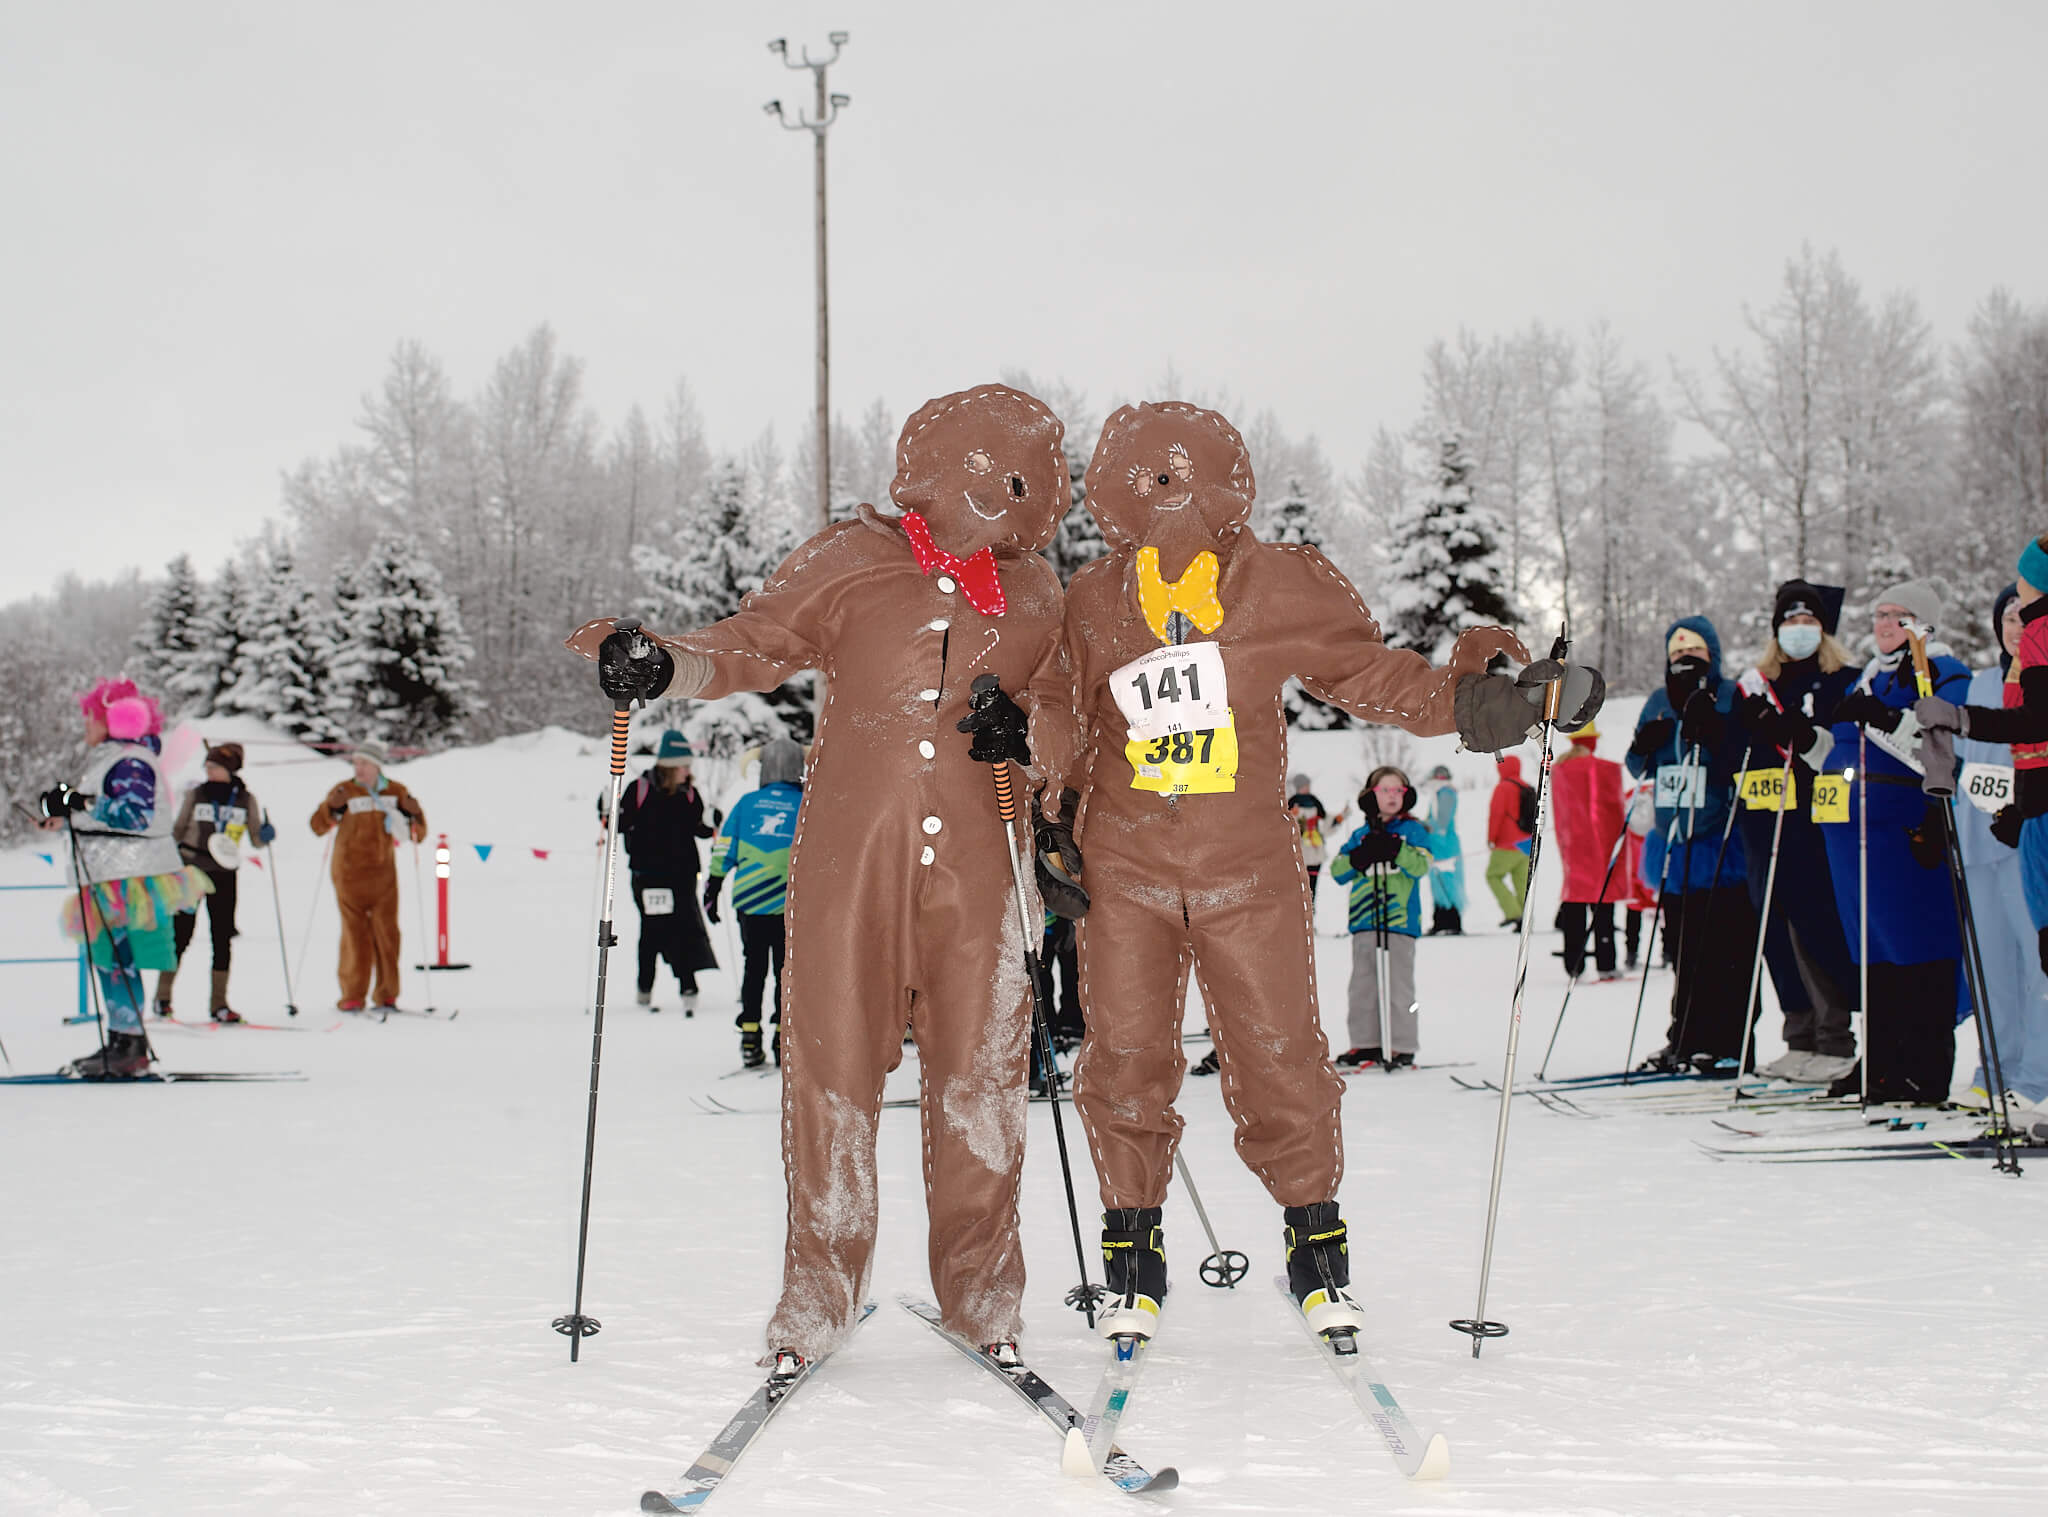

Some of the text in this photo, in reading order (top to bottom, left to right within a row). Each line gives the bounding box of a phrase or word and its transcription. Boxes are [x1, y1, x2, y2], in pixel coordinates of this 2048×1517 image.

[1131, 663, 1201, 710] 141
[1168, 722, 1182, 733] 141
[1145, 728, 1215, 765] 387
[1173, 784, 1189, 793] 387
[1749, 778, 1784, 798] 486
[1814, 787, 1838, 806] 92
[1970, 775, 2009, 799] 685
